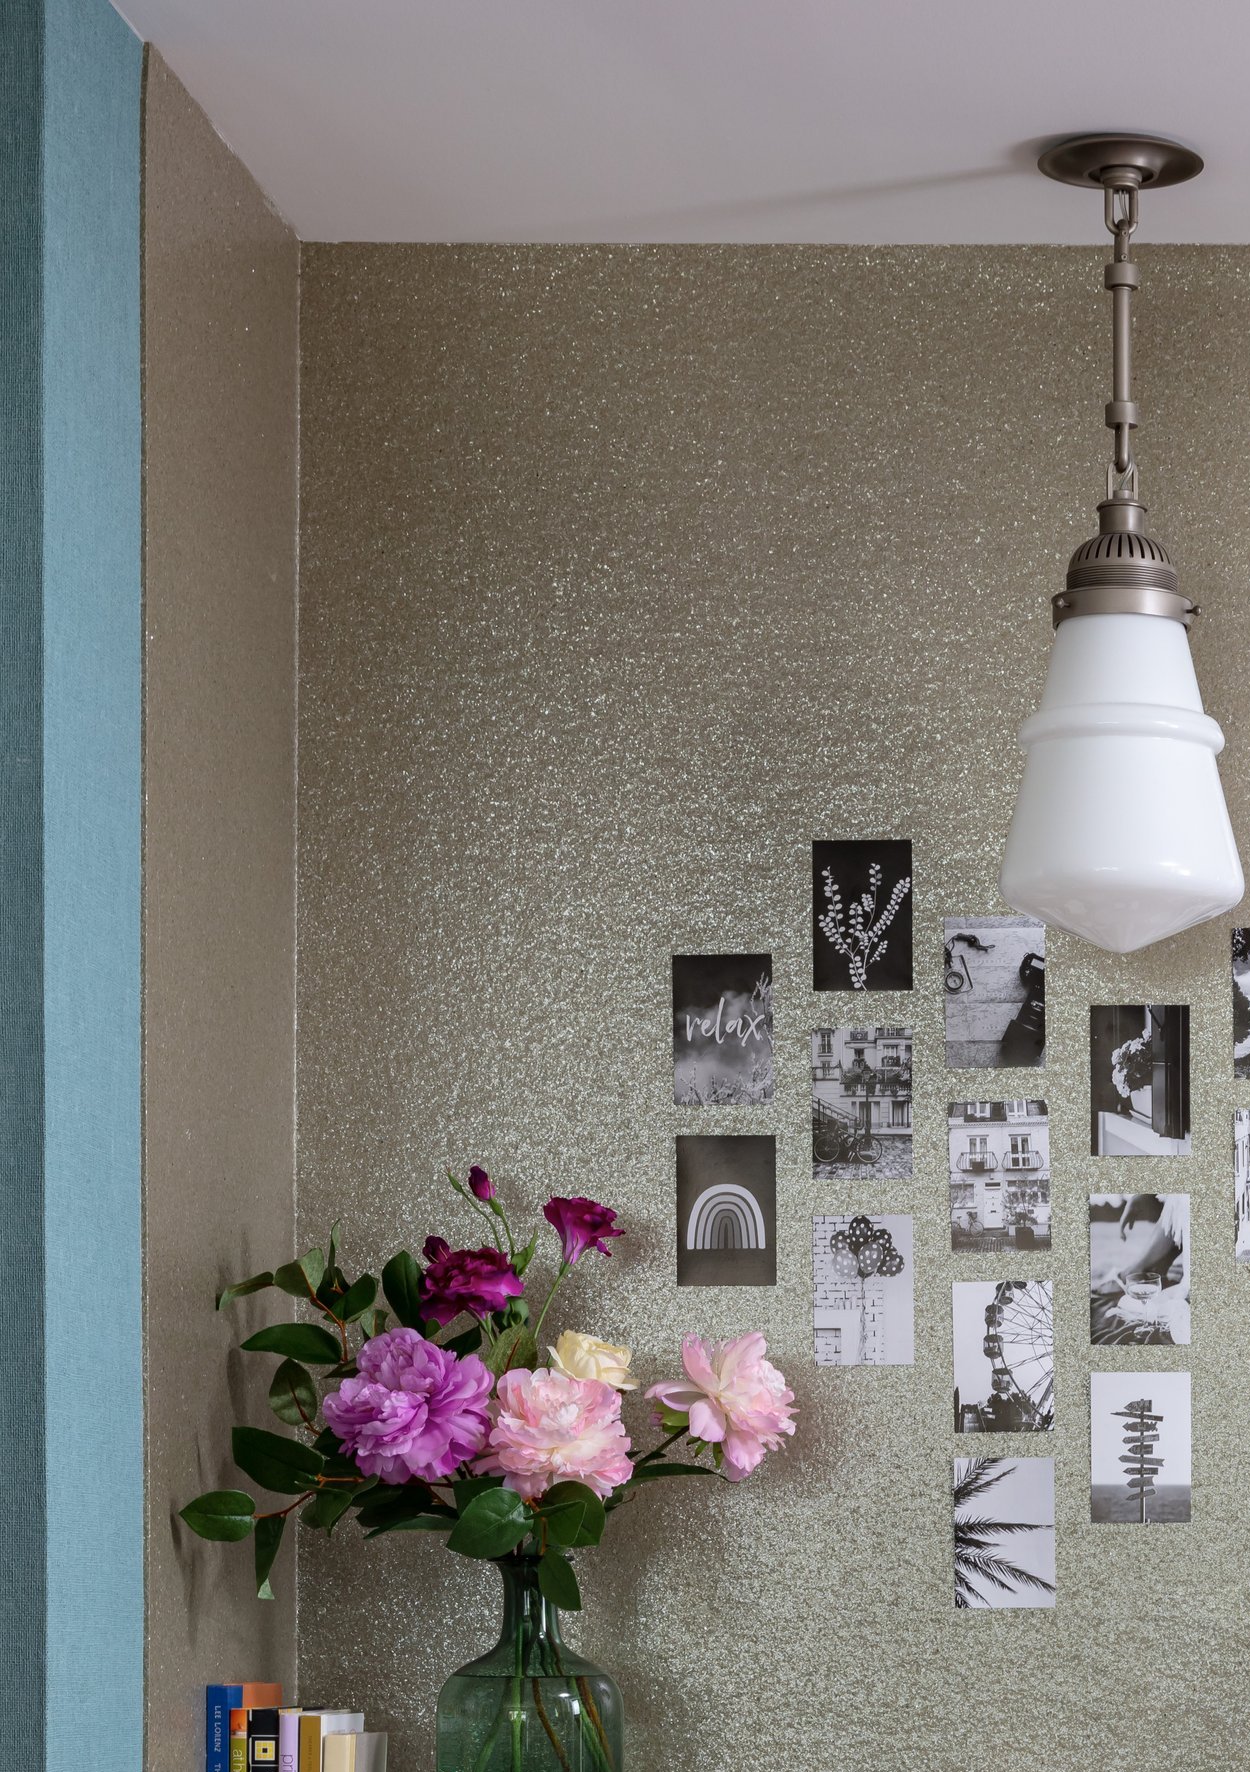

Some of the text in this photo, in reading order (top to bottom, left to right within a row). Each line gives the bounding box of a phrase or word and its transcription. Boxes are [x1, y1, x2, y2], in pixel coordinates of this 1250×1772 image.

[686, 996, 765, 1047] relax
[214, 1705, 222, 1753] LEE LORENZ
[232, 1749, 244, 1761] at
